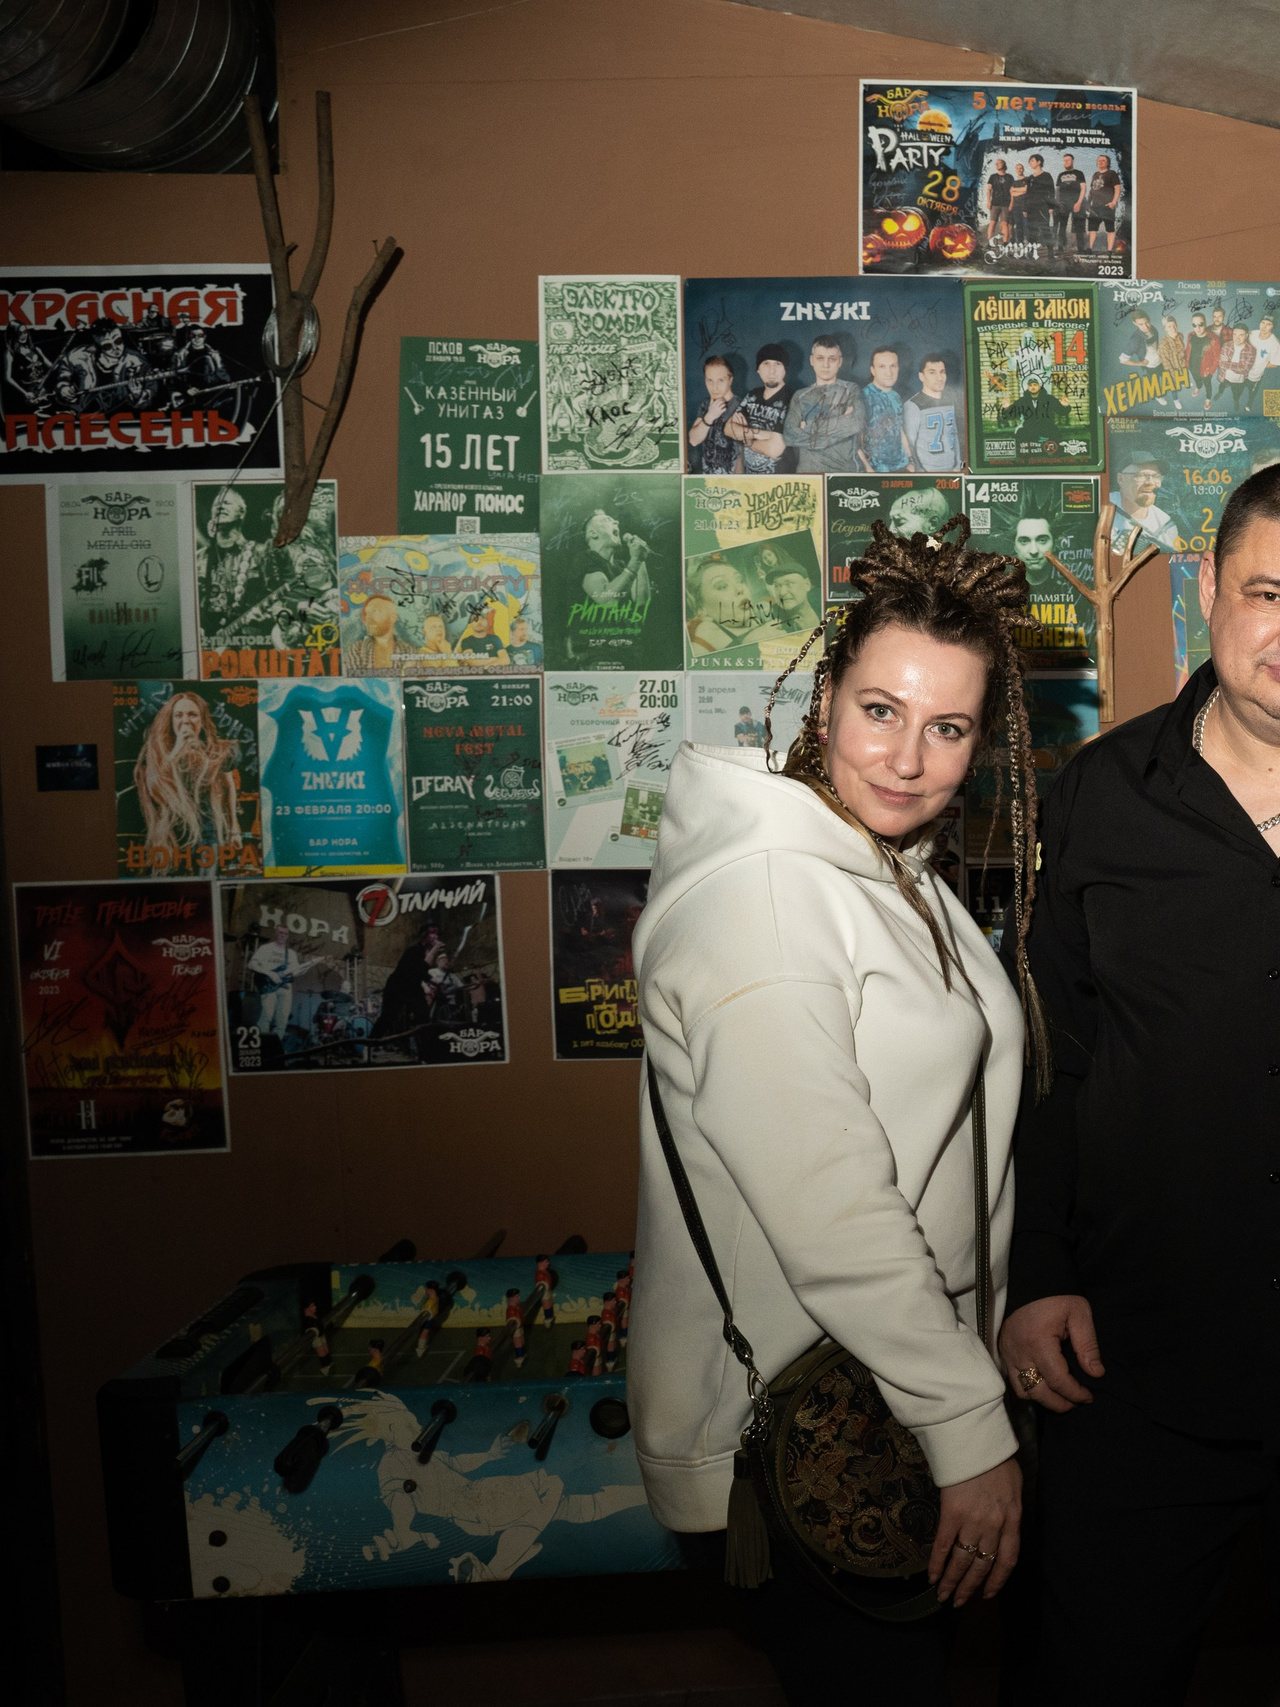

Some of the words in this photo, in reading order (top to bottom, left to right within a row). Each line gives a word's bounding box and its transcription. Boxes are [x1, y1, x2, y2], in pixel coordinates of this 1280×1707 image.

[887, 87, 911, 99] БАР
[972, 92, 986, 110] 5
[995, 96, 1036, 111] лет
[1038, 101, 1082, 111] жуткого
[1085, 104, 1127, 112] веселья
[1004, 125, 1050, 135] Конкурсы,
[1052, 127, 1106, 137] розыгрыши,
[1078, 137, 1111, 145] VAMPIR
[868, 126, 950, 172] PARTY
[922, 170, 962, 202] 28
[917, 196, 959, 215] ОКТЯБРЯ
[1097, 266, 1124, 276] 2023
[1113, 288, 1165, 307] НОРА
[974, 296, 1027, 321] ЛЁША
[1034, 298, 1090, 320] ЗАКОН
[578, 312, 650, 334] ЗОМБИ
[977, 321, 1028, 333] впервые
[1044, 320, 1090, 331] Пскове!
[428, 342, 463, 355] ПСКОВ
[486, 342, 508, 351] БАР
[1052, 331, 1087, 365] 14
[1051, 364, 1089, 373] апреля
[1103, 367, 1190, 416] ХЕЙМАН
[437, 404, 504, 420] УНИТАЗ
[4, 410, 240, 452] ПЛЕСЕНЬ
[1193, 423, 1225, 434] БАР
[420, 433, 452, 468] 15
[460, 434, 520, 472] ЛЕТ
[1179, 438, 1248, 459] НОРА
[1183, 469, 1232, 485] 16.06
[882, 480, 890, 488] 23
[890, 480, 914, 488] АПРЕЛЯ
[936, 479, 960, 489] 20:00
[990, 482, 1018, 492] мая
[105, 491, 131, 502] БАР
[706, 486, 727, 495] БАР
[847, 487, 867, 496] БАР
[967, 482, 991, 503] 14
[475, 493, 524, 514] ПОНОС
[991, 493, 1018, 502] 20:00
[694, 520, 741, 531] 21.01.23
[1029, 593, 1074, 602] ПАМЯТИ
[202, 649, 341, 679] РОКШТАТ
[426, 682, 451, 692] БАР
[566, 682, 585, 690] БАР
[639, 679, 676, 693] 27.01
[491, 695, 532, 707] 21:00
[639, 694, 678, 708] 20:00
[570, 718, 621, 726] ОТБОРОЧНЫЙ
[275, 805, 290, 815] 23
[294, 805, 351, 815] ФЕВРАЛЯ
[356, 803, 392, 814] 20:00
[309, 838, 329, 846] БАР
[331, 837, 358, 846] НОРА
[259, 905, 349, 945] НОРА
[171, 934, 195, 944] БАР
[38, 985, 60, 996] 2023
[236, 1025, 262, 1049] 23
[459, 1030, 483, 1038] БАР
[239, 1056, 262, 1067] 2023
